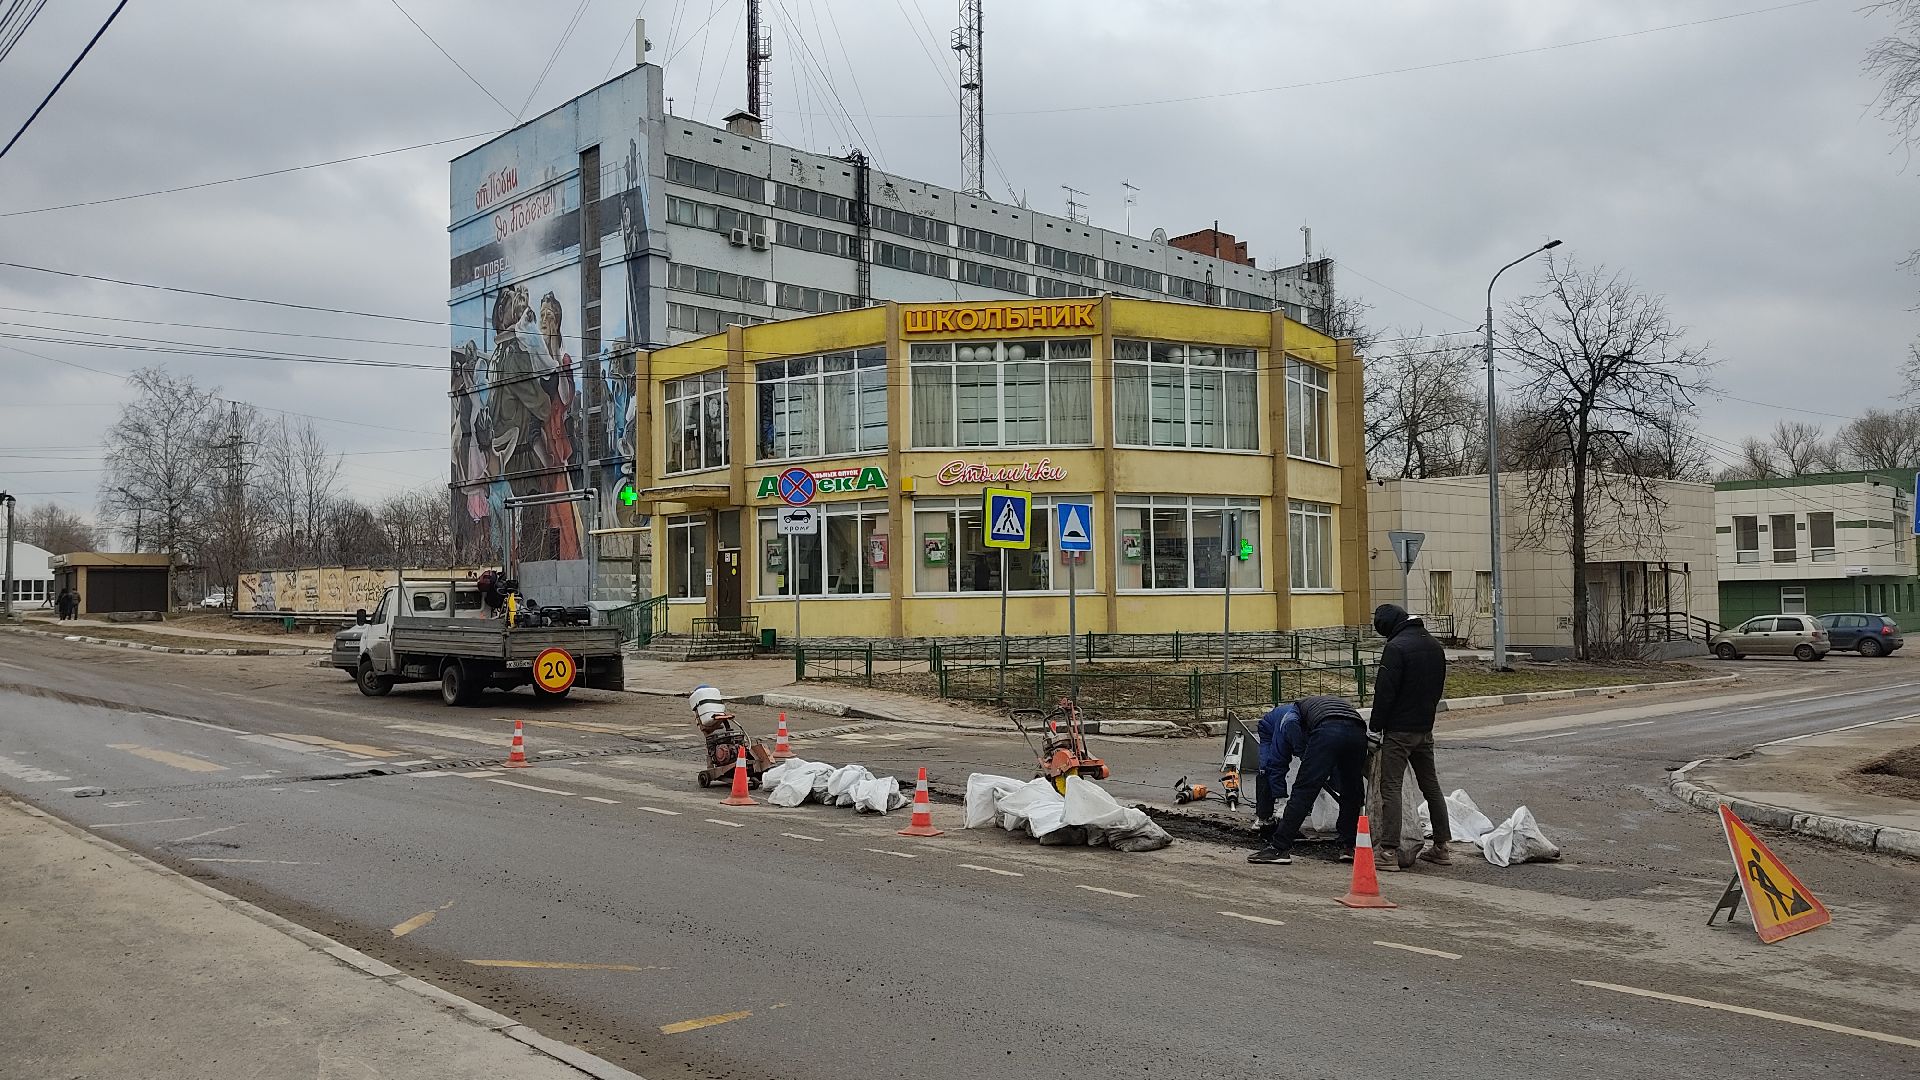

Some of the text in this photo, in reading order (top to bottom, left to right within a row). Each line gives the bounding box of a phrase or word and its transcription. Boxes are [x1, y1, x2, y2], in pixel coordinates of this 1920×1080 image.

[474, 266, 480, 280] С
[905, 304, 1096, 332] ШКОЛЬНИК
[756, 466, 888, 499] АекА
[936, 457, 1067, 486] Столички
[543, 660, 567, 680] 20
